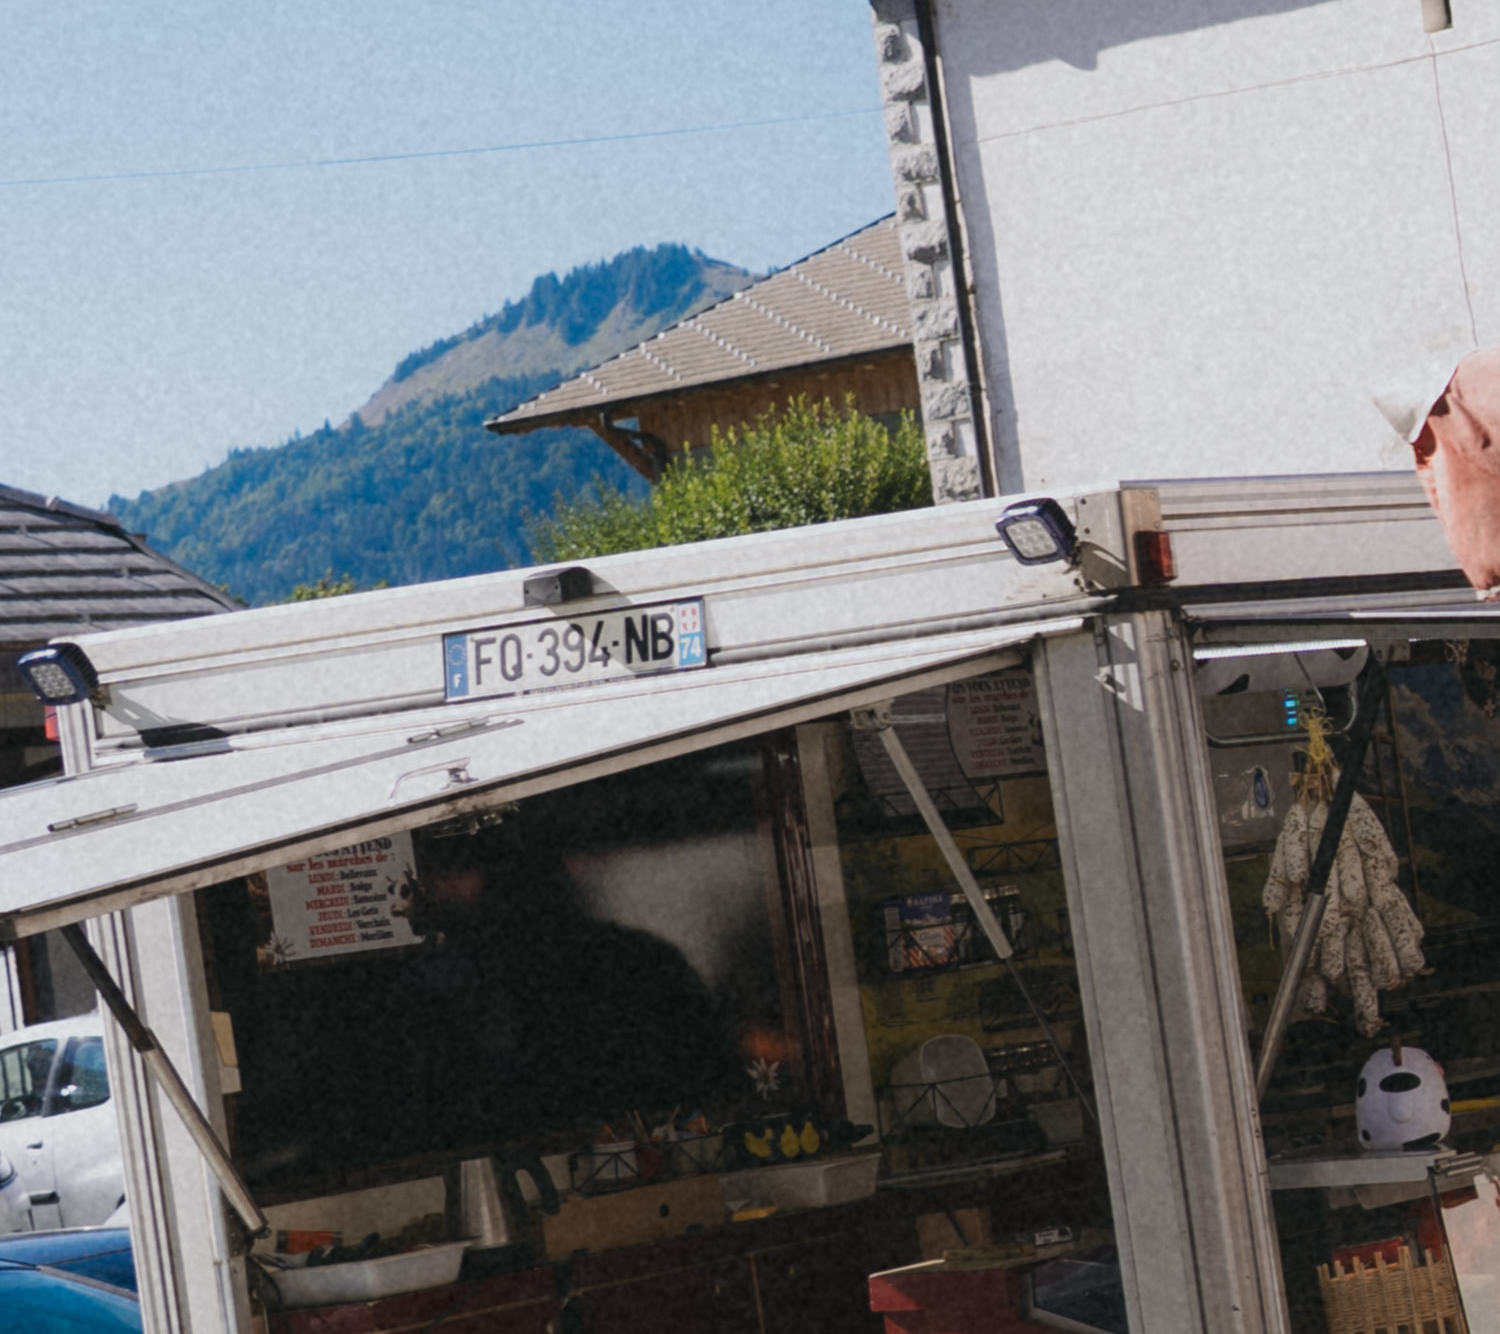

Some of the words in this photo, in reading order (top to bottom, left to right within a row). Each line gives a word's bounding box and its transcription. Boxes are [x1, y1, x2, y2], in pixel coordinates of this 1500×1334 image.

[474, 613, 675, 685] FQ-394-NB
[680, 637, 702, 659] 74
[453, 673, 463, 690] F
